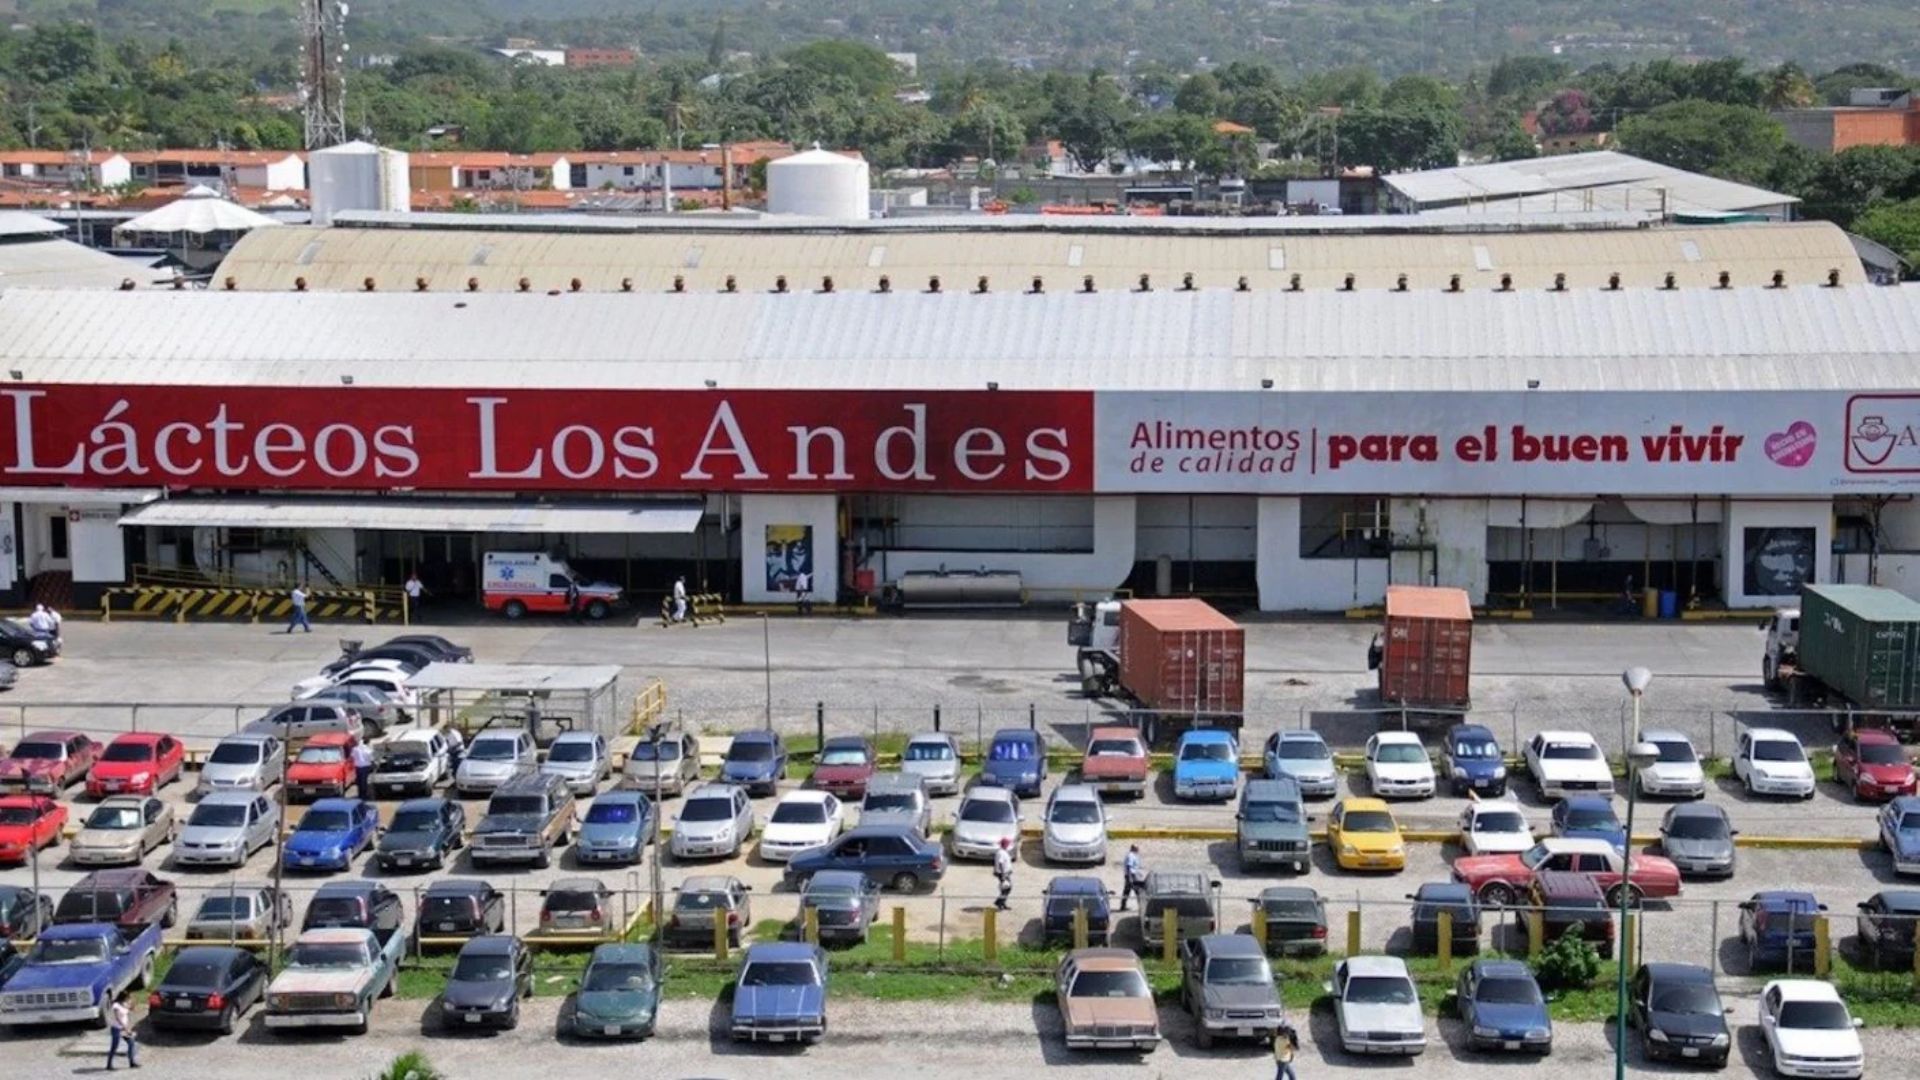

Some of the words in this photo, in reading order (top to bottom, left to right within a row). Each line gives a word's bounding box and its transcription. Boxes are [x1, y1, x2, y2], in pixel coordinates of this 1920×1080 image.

[0, 390, 420, 478] Lácteos
[467, 396, 659, 479] Los
[681, 399, 1071, 481] Andes
[1130, 421, 1300, 451] Alimentos
[1329, 435, 1438, 469] para
[1456, 426, 1498, 461] el
[1512, 426, 1629, 462] buen
[1642, 426, 1744, 462] vivir
[1130, 451, 1164, 473] de
[1178, 451, 1296, 473] calidad
